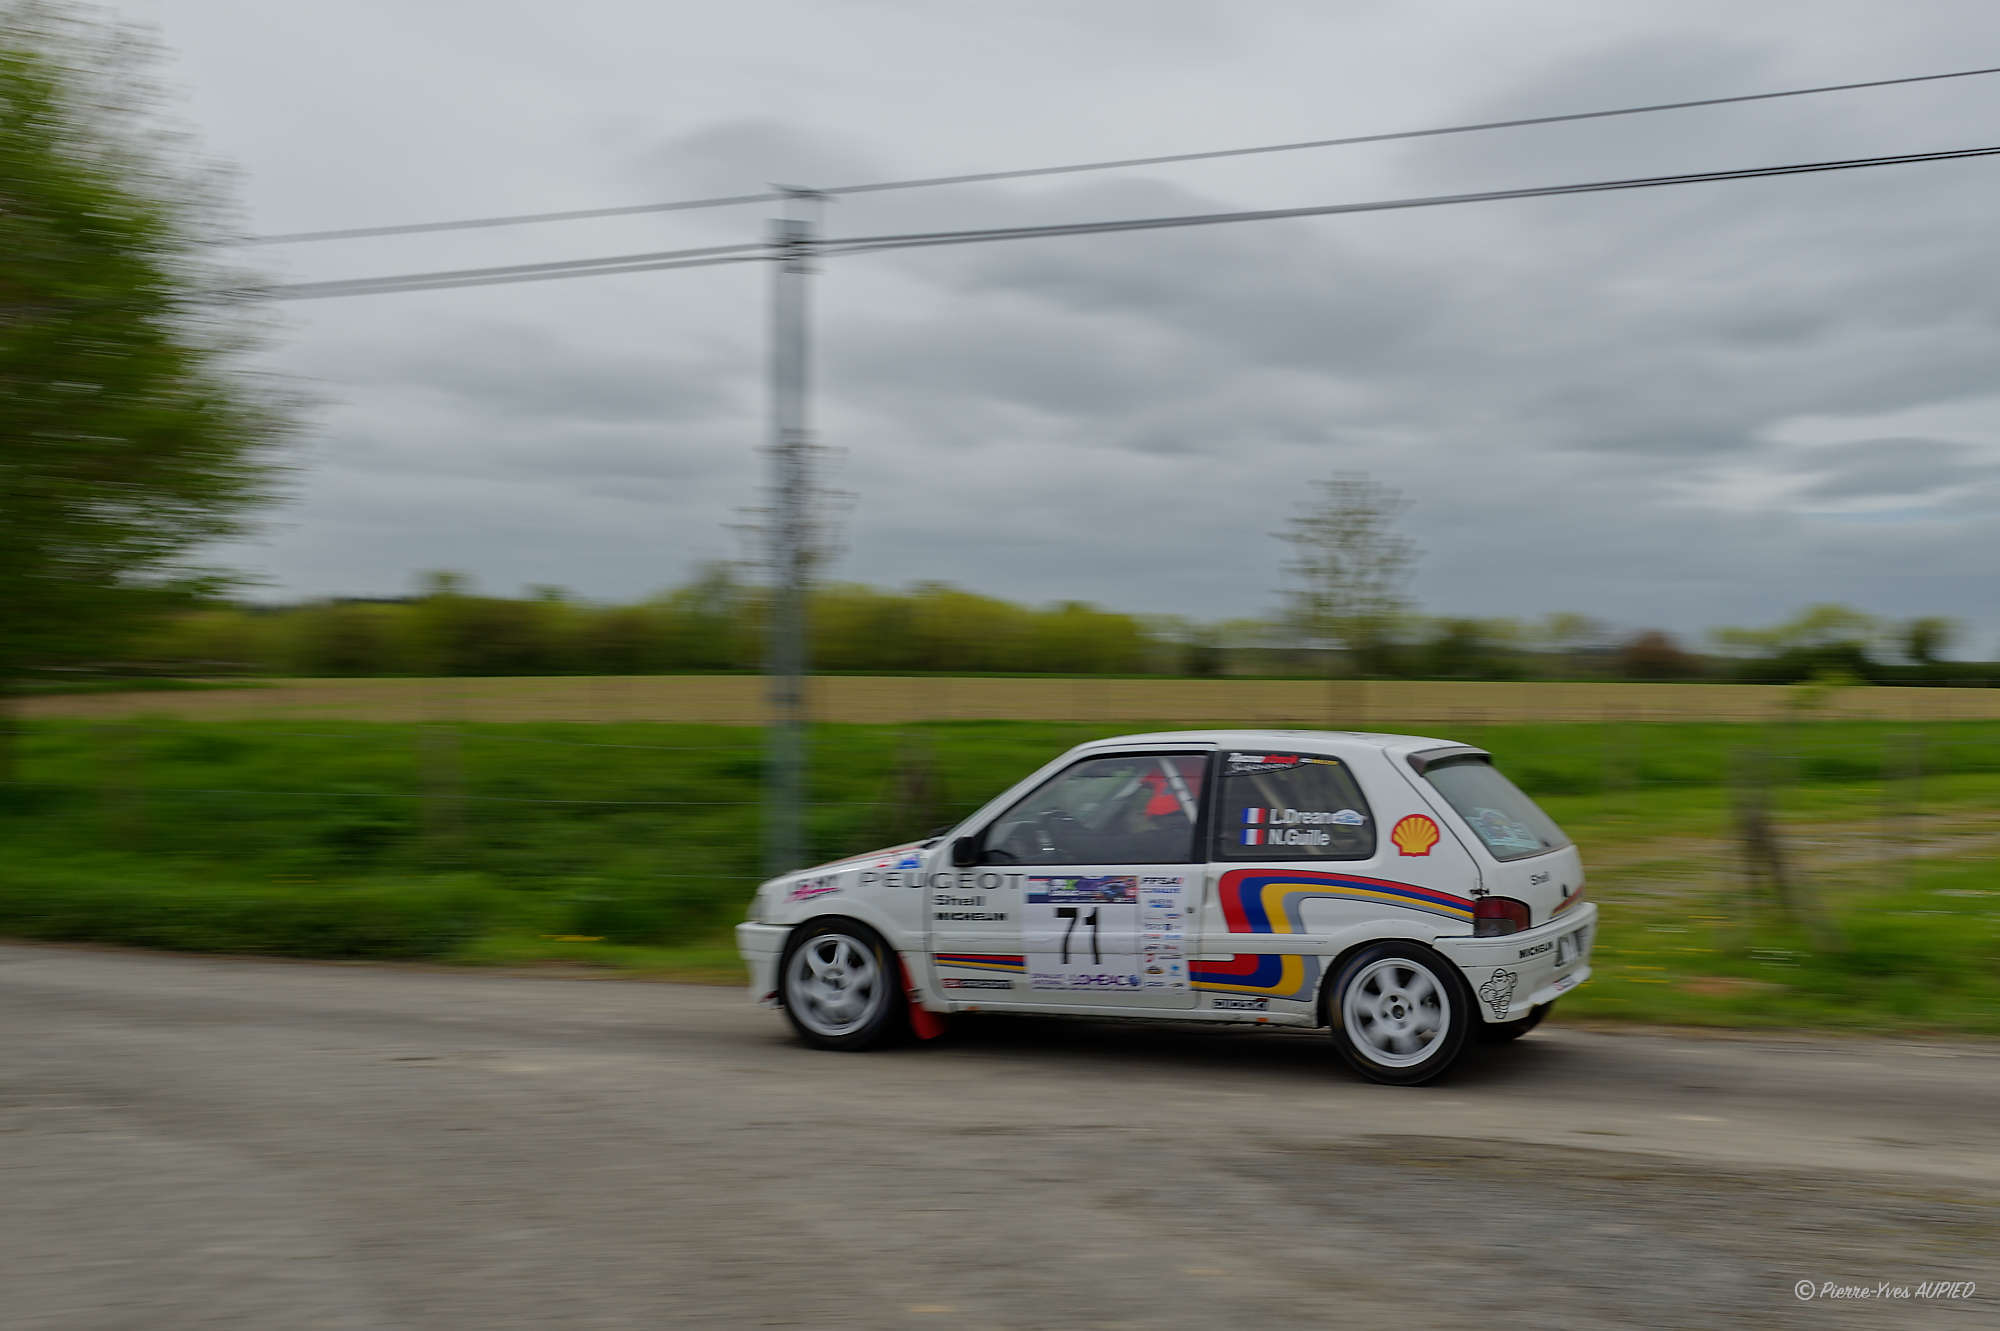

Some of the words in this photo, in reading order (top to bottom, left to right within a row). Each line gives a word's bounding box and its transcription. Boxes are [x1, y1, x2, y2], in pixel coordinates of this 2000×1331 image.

[858, 872, 1024, 889] PEUGEOT
[934, 895, 986, 906] Shell
[935, 912, 1008, 921] MICHELIN
[1055, 907, 1102, 965] 71
[1518, 941, 1554, 959] MICHELIN
